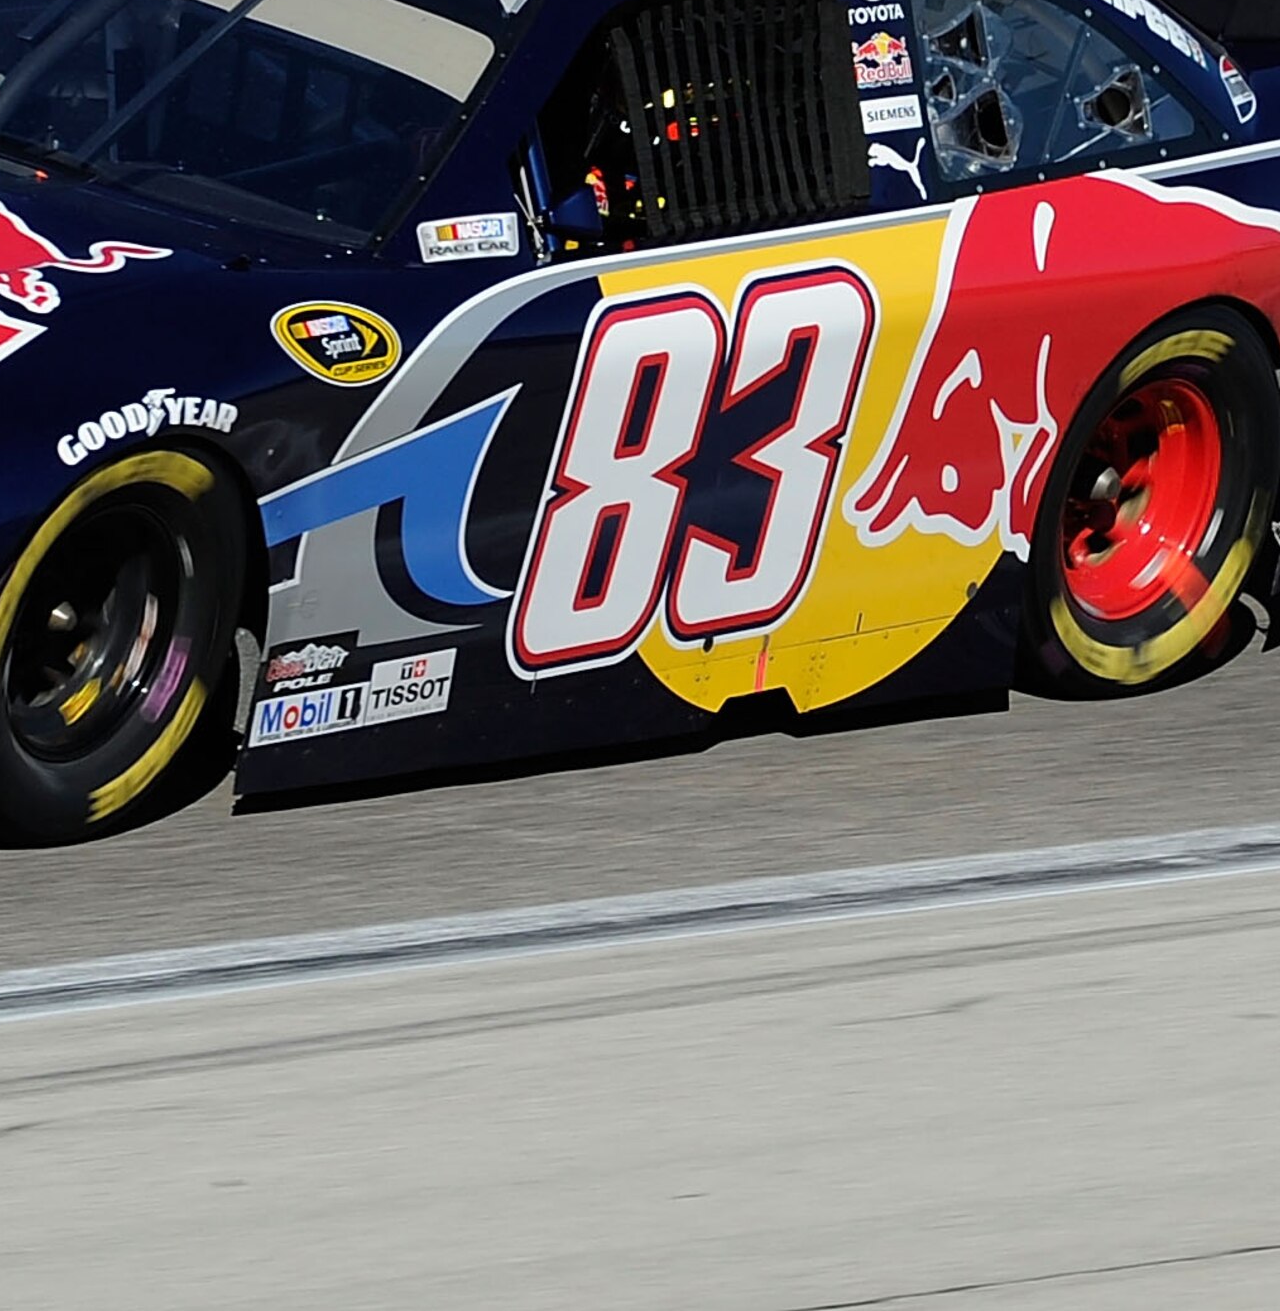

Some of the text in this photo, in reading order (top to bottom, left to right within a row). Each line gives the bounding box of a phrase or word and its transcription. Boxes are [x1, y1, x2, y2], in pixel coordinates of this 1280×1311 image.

[848, 3, 905, 26] TOYOTA
[854, 61, 886, 83] Red
[885, 58, 913, 80] Bull
[866, 105, 916, 123] SIEMENS
[456, 219, 504, 240] NASCAR
[428, 240, 511, 256] RACE CAR
[321, 332, 362, 359] Sprint
[333, 359, 388, 376] CUP SERIES
[57, 388, 239, 465] GOODYEAR
[506, 257, 882, 680] 83
[273, 673, 334, 692] POLE
[372, 676, 450, 709] TISSOT
[259, 691, 333, 735] Mobil
[343, 689, 357, 719] 1
